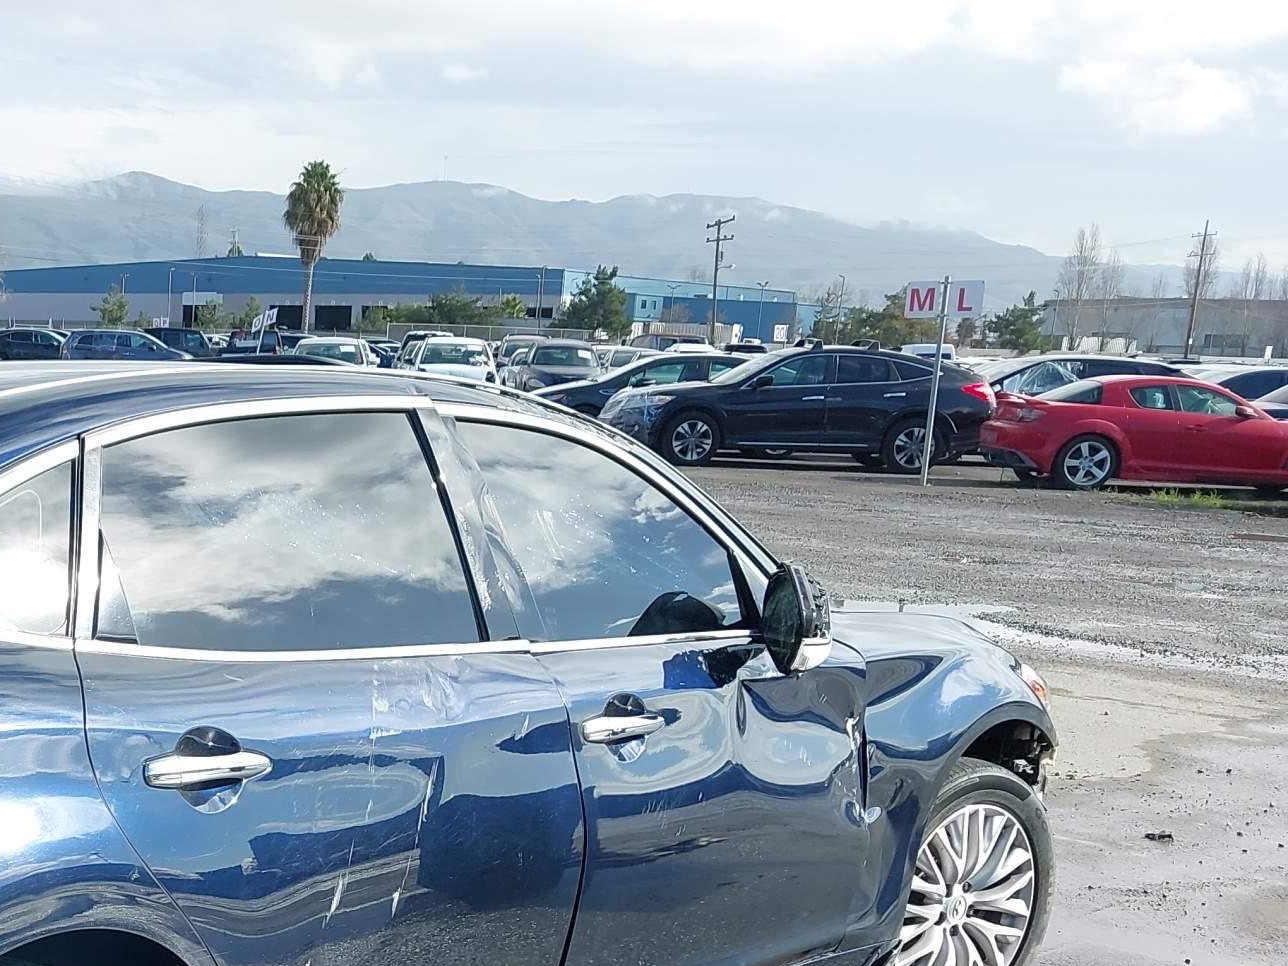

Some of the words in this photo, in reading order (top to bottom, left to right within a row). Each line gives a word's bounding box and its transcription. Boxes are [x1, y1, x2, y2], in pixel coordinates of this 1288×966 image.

[909, 287, 935, 311] M
[957, 287, 972, 311] L
[775, 326, 785, 340] 20
